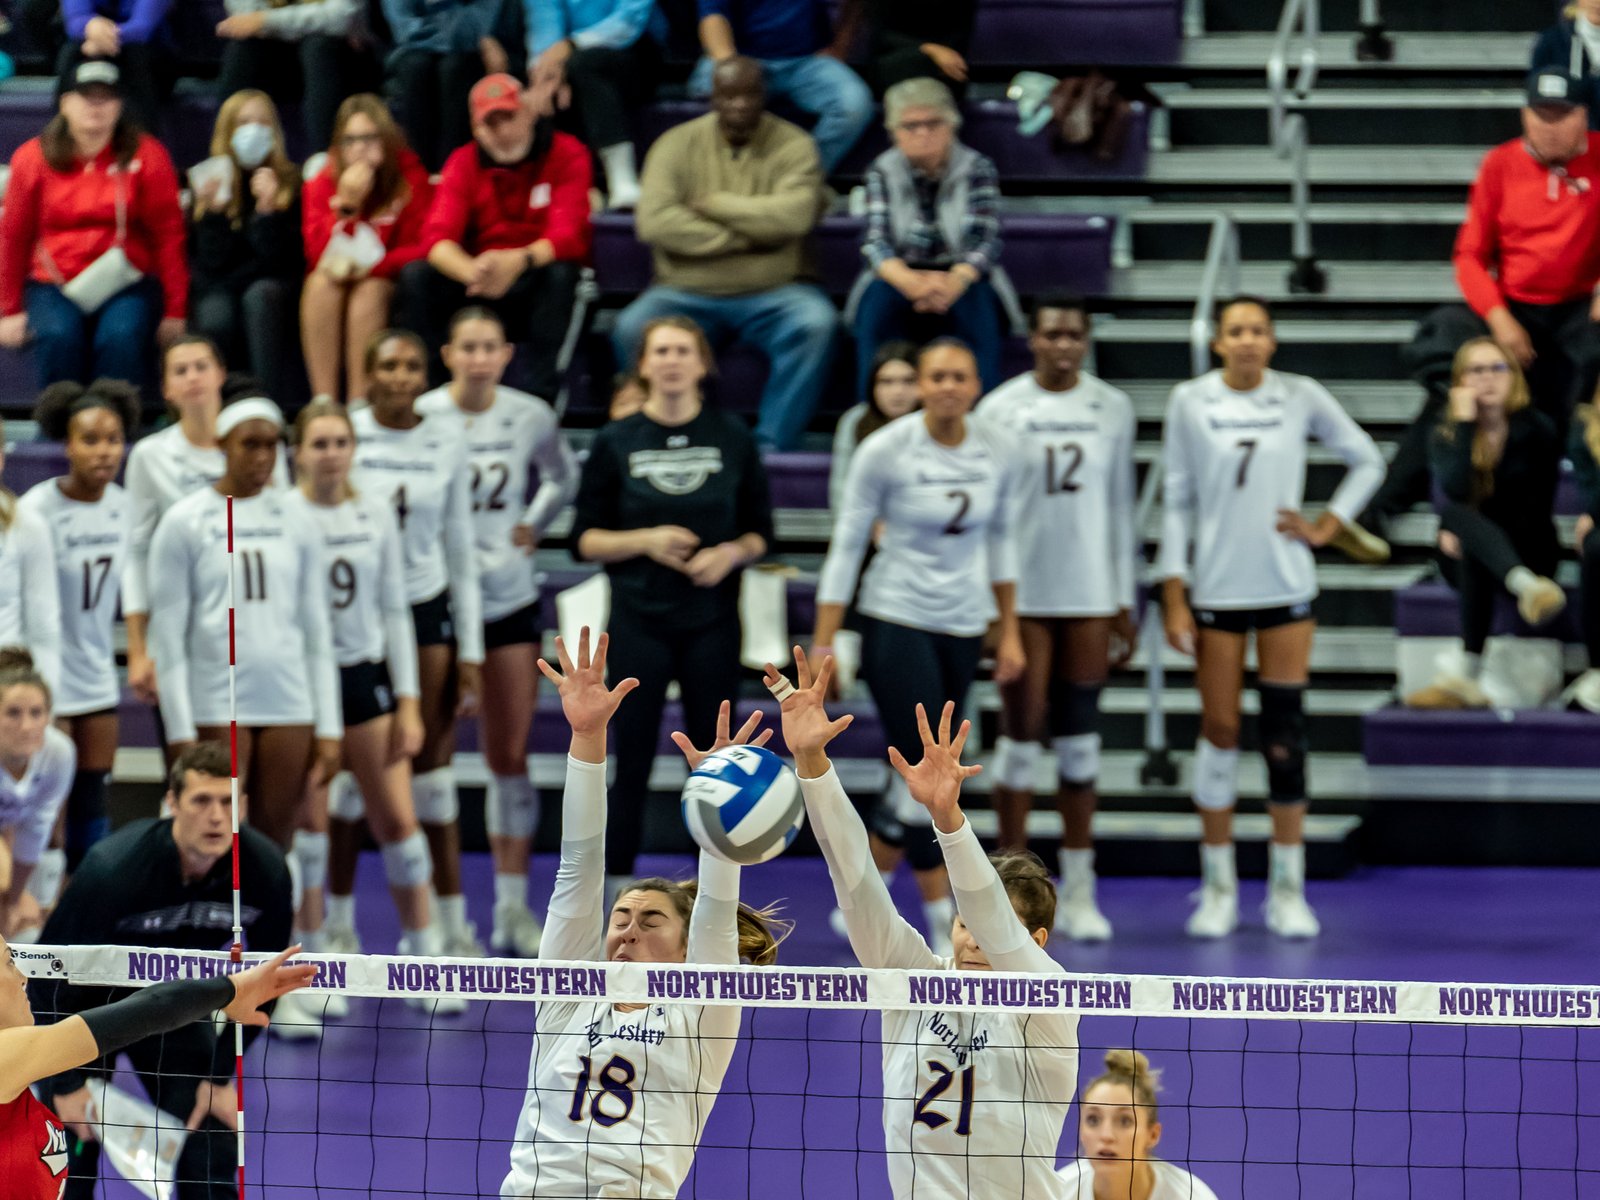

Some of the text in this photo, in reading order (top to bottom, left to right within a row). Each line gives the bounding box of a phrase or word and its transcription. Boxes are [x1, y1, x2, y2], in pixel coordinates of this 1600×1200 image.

[1044, 442, 1083, 495] 12
[1236, 439, 1258, 490] 7
[943, 491, 971, 536] 2
[82, 555, 113, 611] 17
[242, 549, 267, 601] 11
[329, 556, 357, 609] 9
[20, 951, 55, 960] Senoh
[128, 951, 347, 989] NORTHWRN
[387, 962, 607, 997] NORTHWESTERN
[646, 969, 868, 1003] NORTHWESTERN
[908, 975, 1132, 1010] NORTHWESTERN
[1172, 982, 1397, 1015] NORTHWESTERN
[567, 1053, 636, 1128] 18
[913, 1060, 976, 1136] 21
